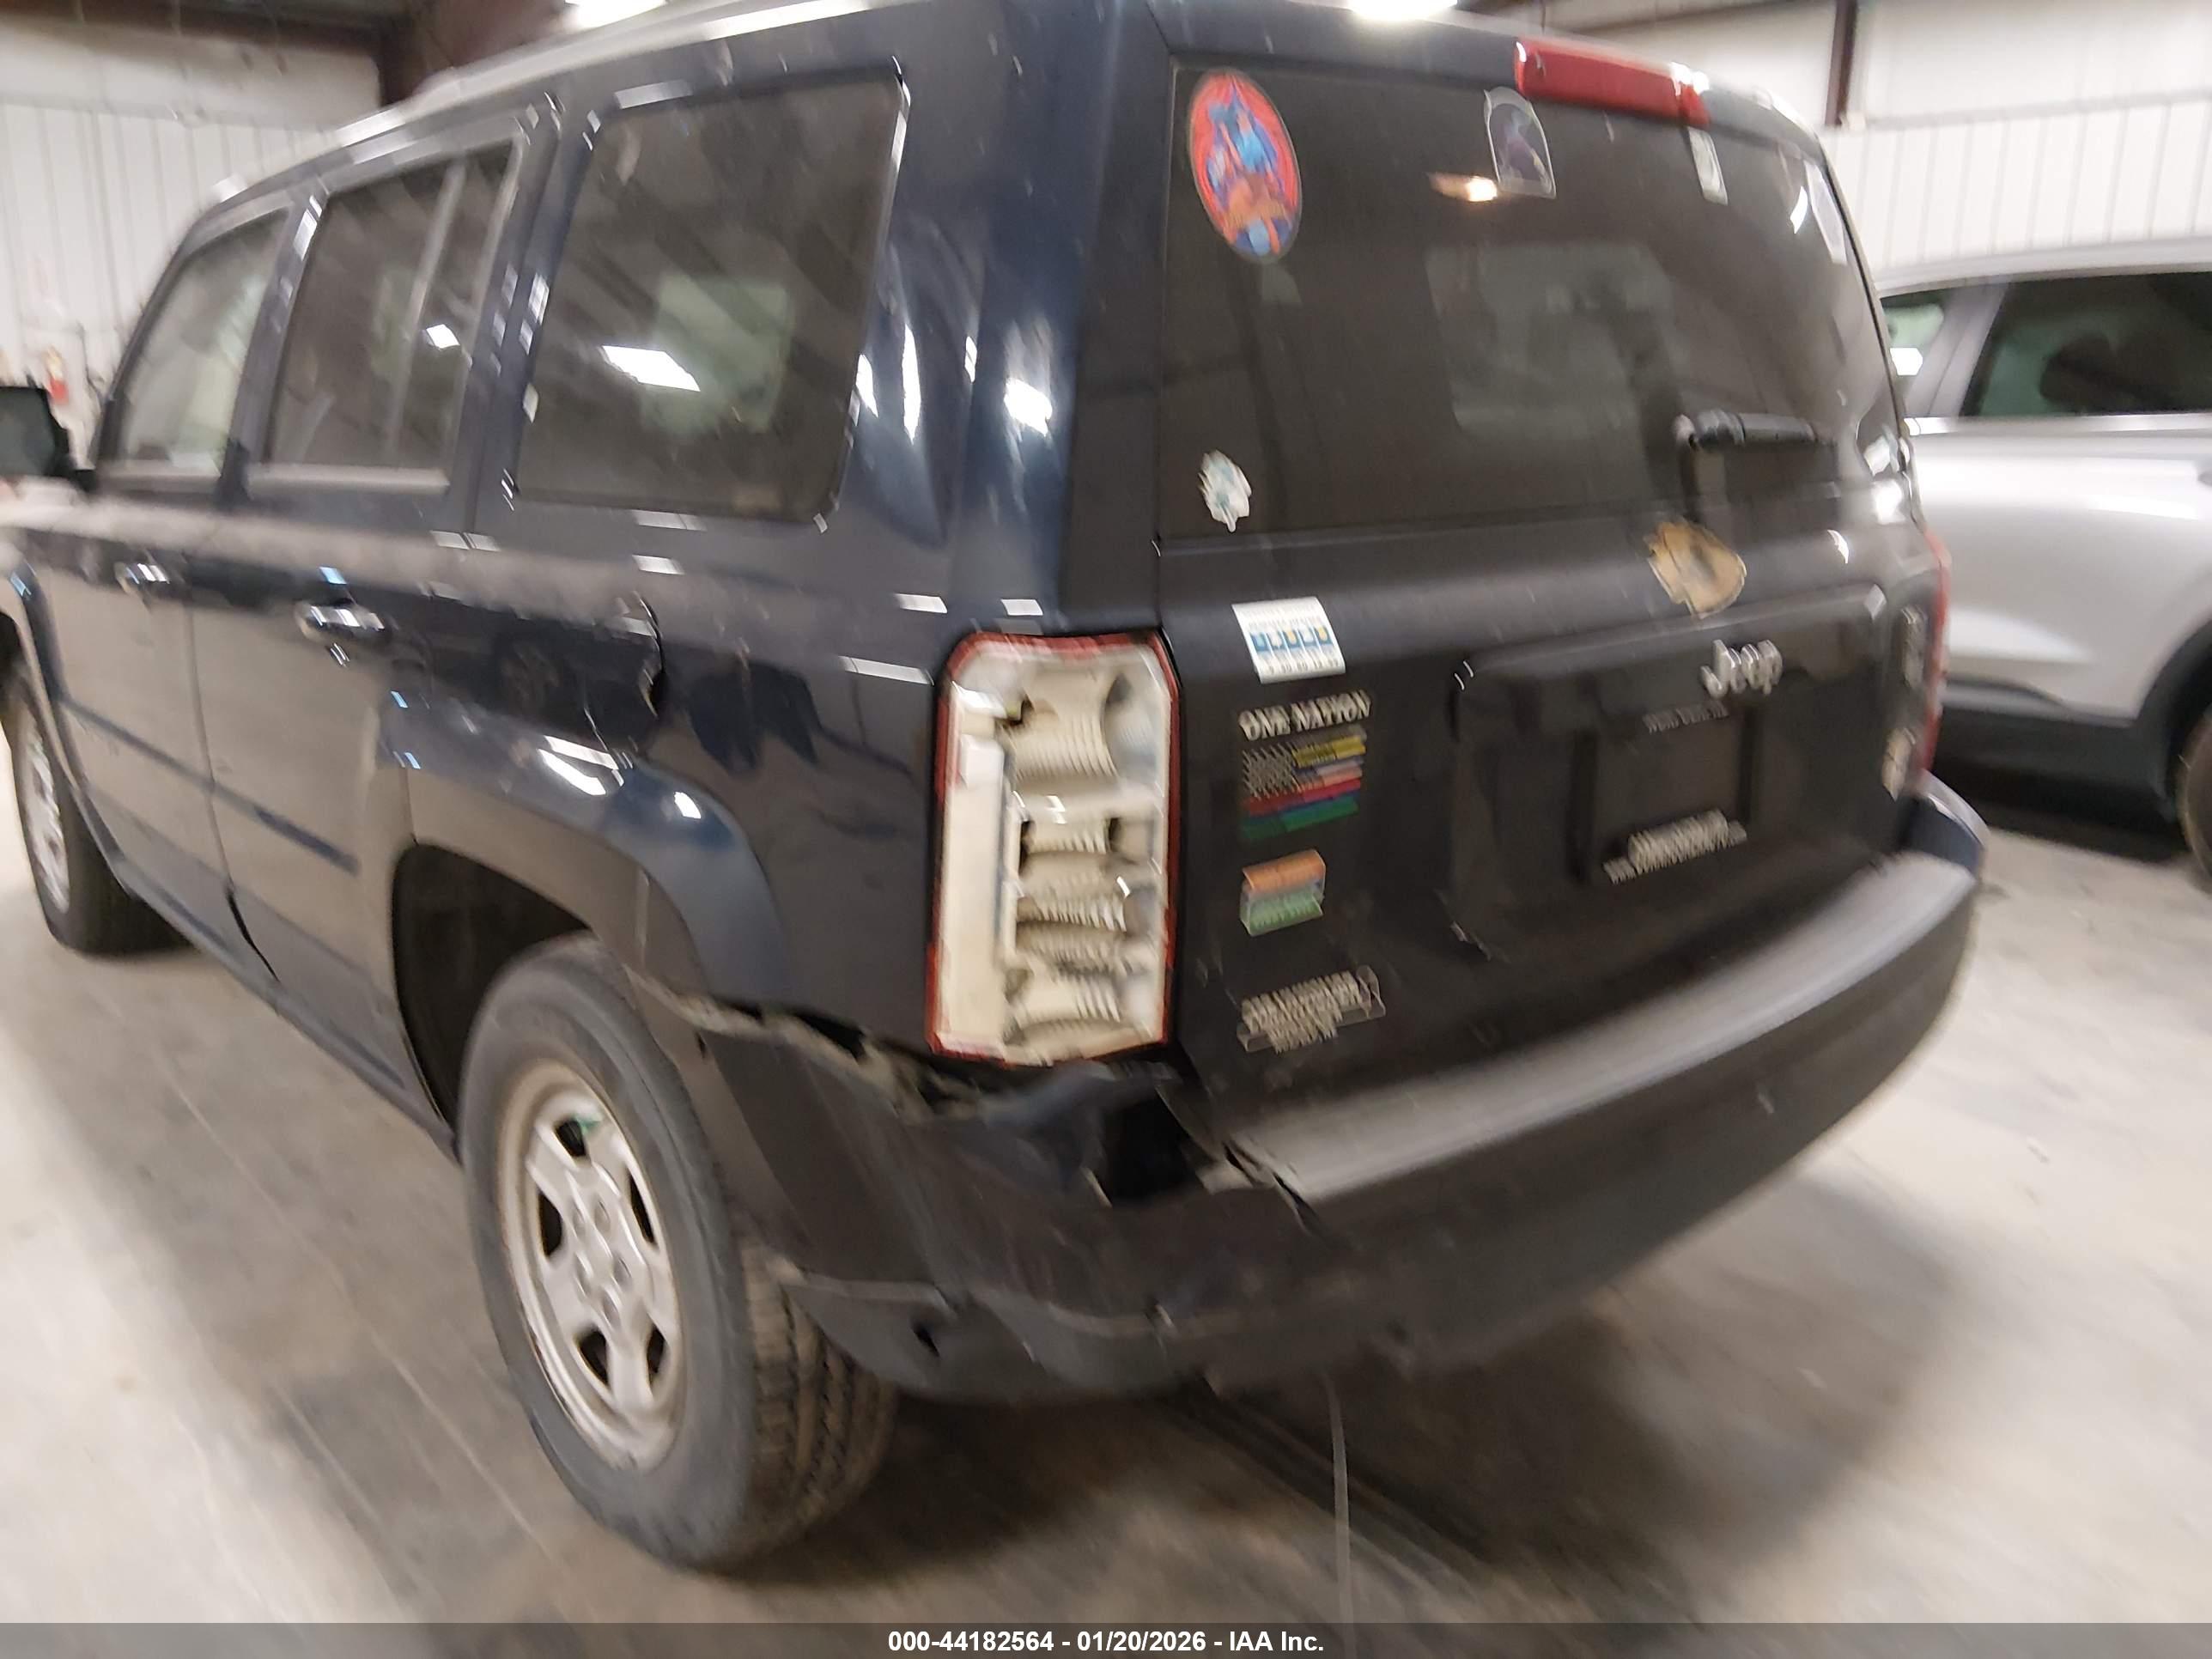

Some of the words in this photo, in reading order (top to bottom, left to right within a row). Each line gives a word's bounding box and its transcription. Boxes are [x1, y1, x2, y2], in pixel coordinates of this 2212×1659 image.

[1699, 639, 1783, 699] Jeep
[1238, 705, 1291, 742] ONE
[1291, 689, 1372, 732] NATION
